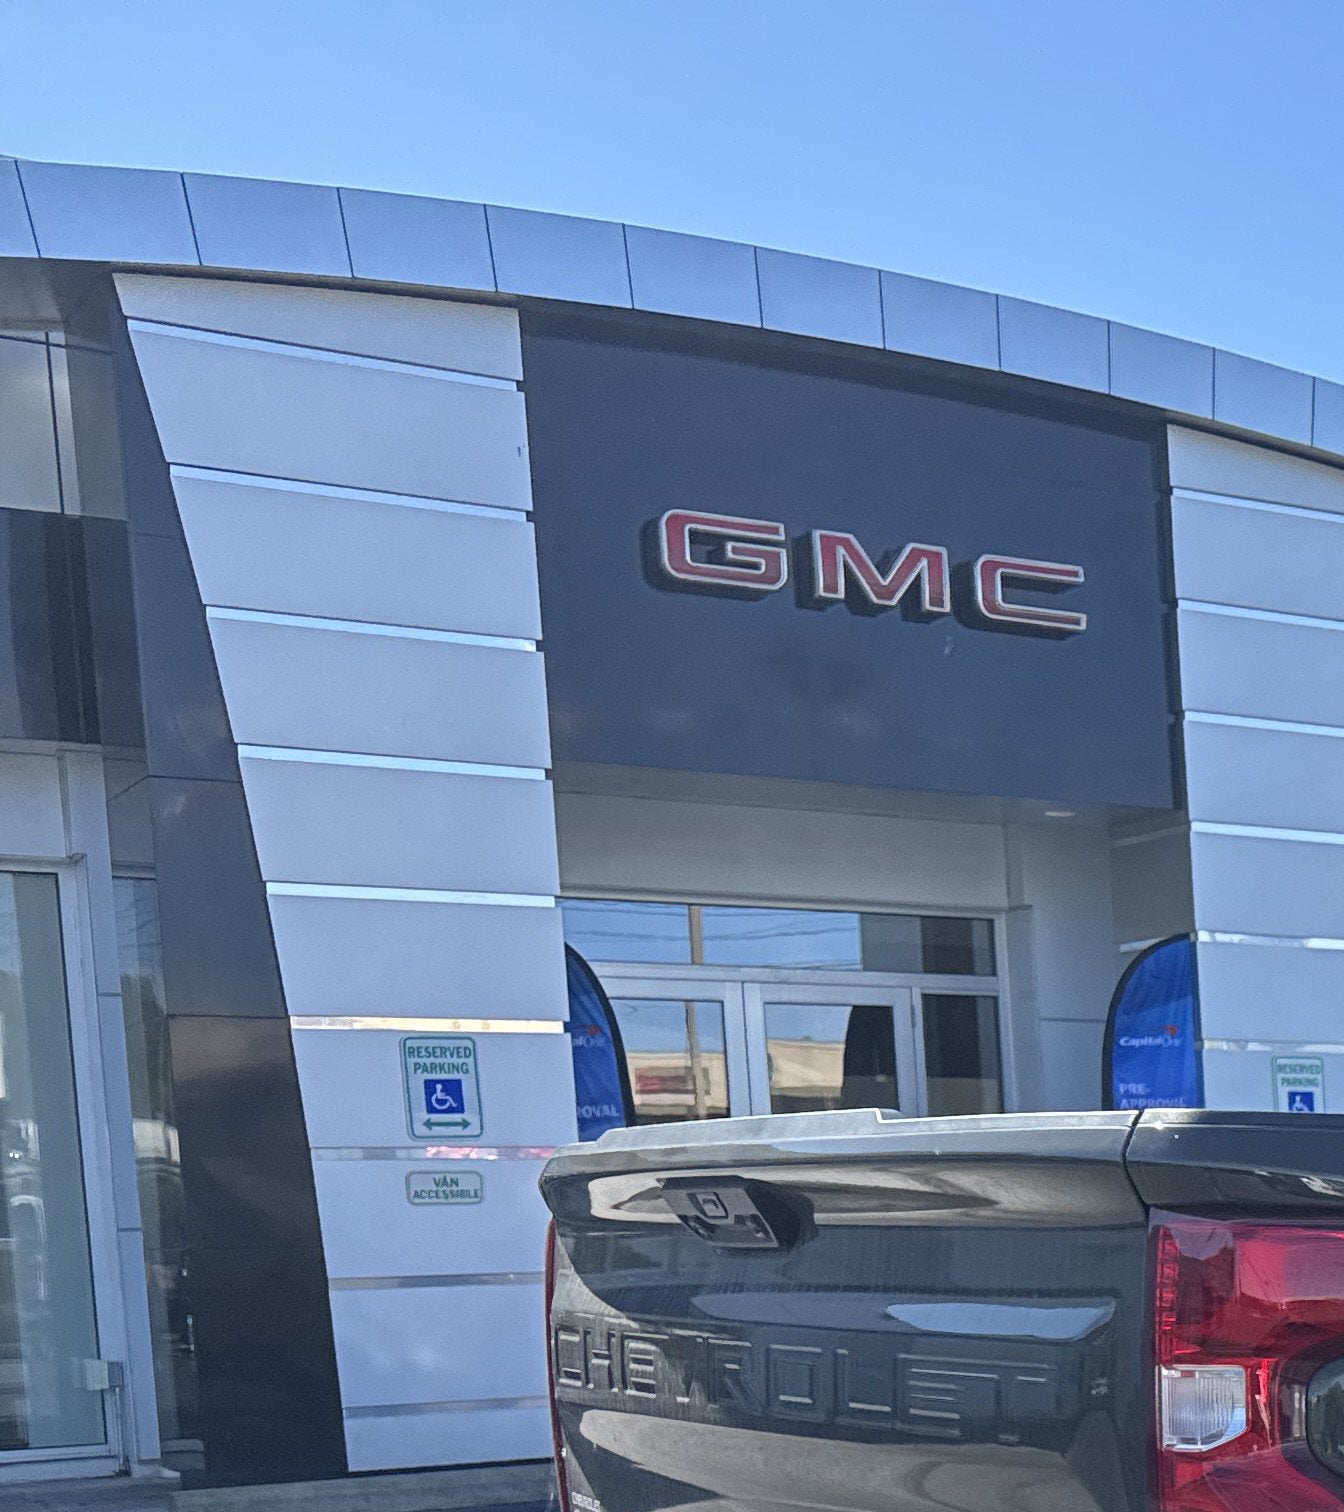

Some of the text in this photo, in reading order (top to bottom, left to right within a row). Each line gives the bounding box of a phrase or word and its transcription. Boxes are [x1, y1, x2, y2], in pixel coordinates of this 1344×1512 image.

[658, 508, 1087, 631] GMC
[407, 1045, 472, 1060] RESERVED
[413, 1061, 470, 1076] PARKING
[432, 1174, 460, 1188] VAN
